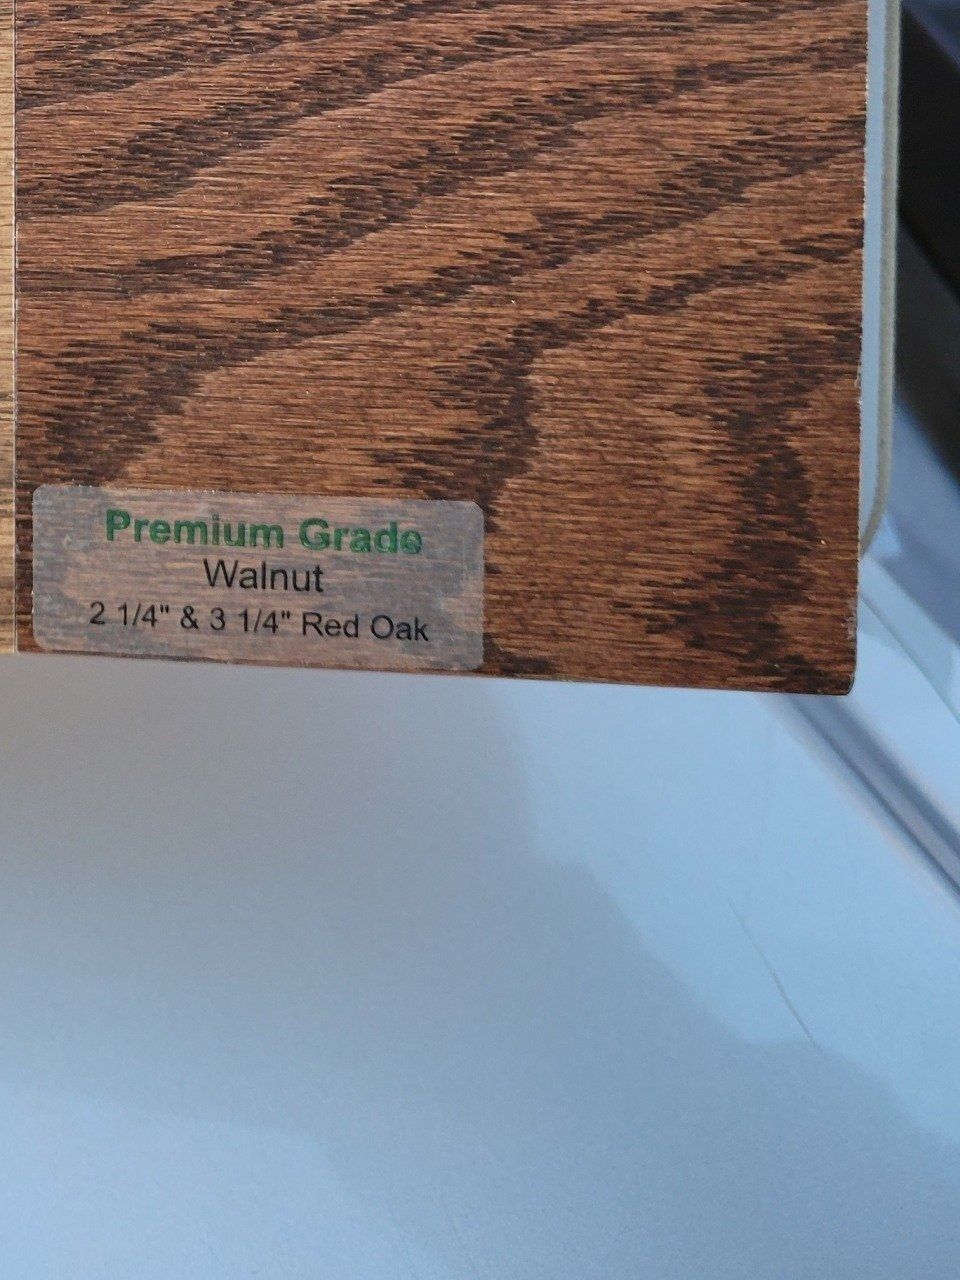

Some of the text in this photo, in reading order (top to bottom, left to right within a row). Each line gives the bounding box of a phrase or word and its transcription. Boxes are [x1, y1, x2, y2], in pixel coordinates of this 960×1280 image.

[105, 509, 423, 554] Premium Grade
[202, 558, 324, 593] Walnut
[89, 601, 429, 642] 2 1/4" & 3 1/4" Red Oak
